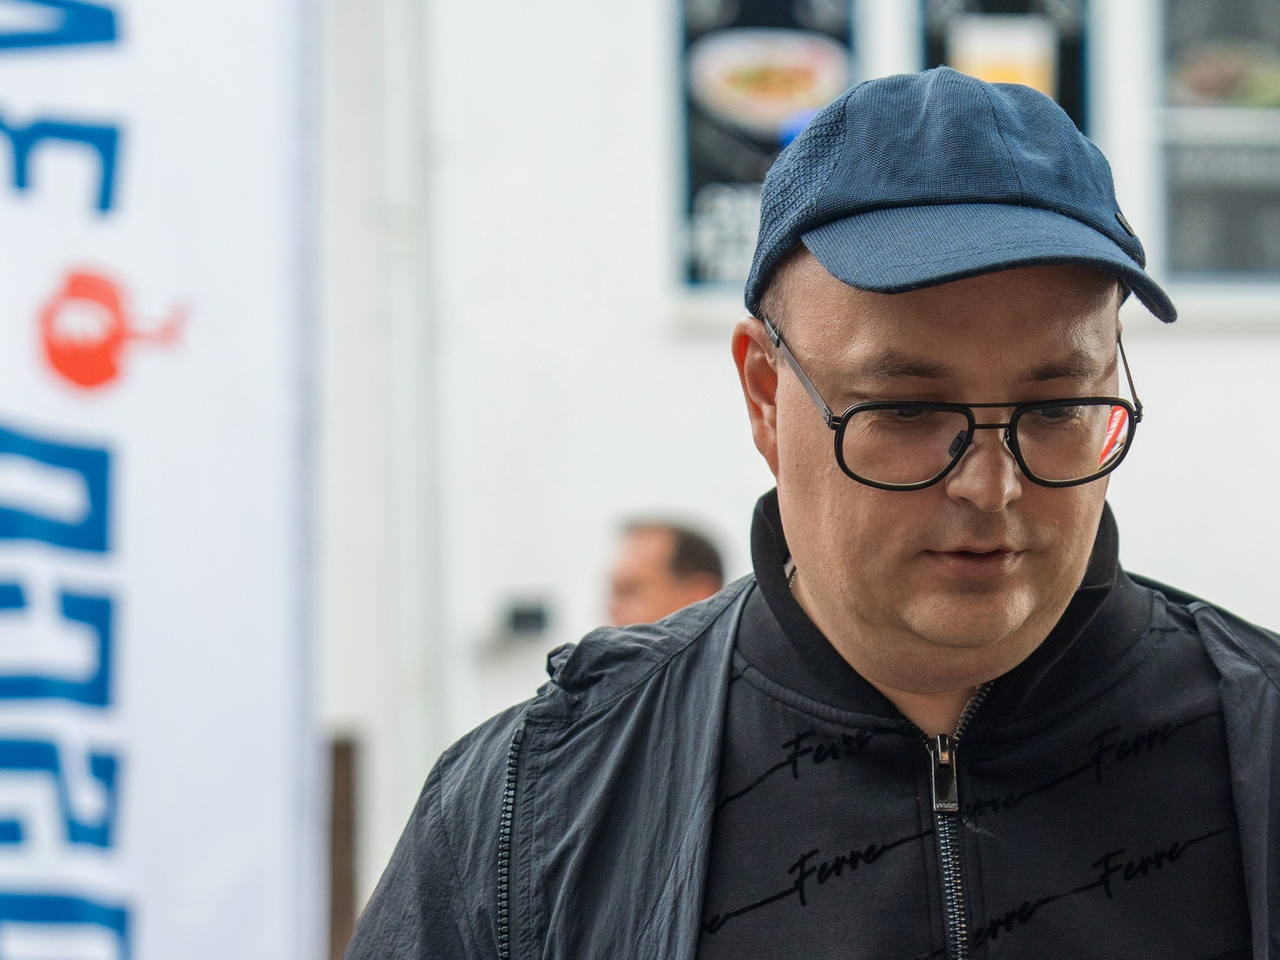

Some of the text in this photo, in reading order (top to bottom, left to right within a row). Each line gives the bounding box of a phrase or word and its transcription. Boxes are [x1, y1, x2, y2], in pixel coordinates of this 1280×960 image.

[788, 844, 889, 906] Ferre
[1092, 841, 1191, 899] Ferre
[973, 901, 1037, 948] erre
